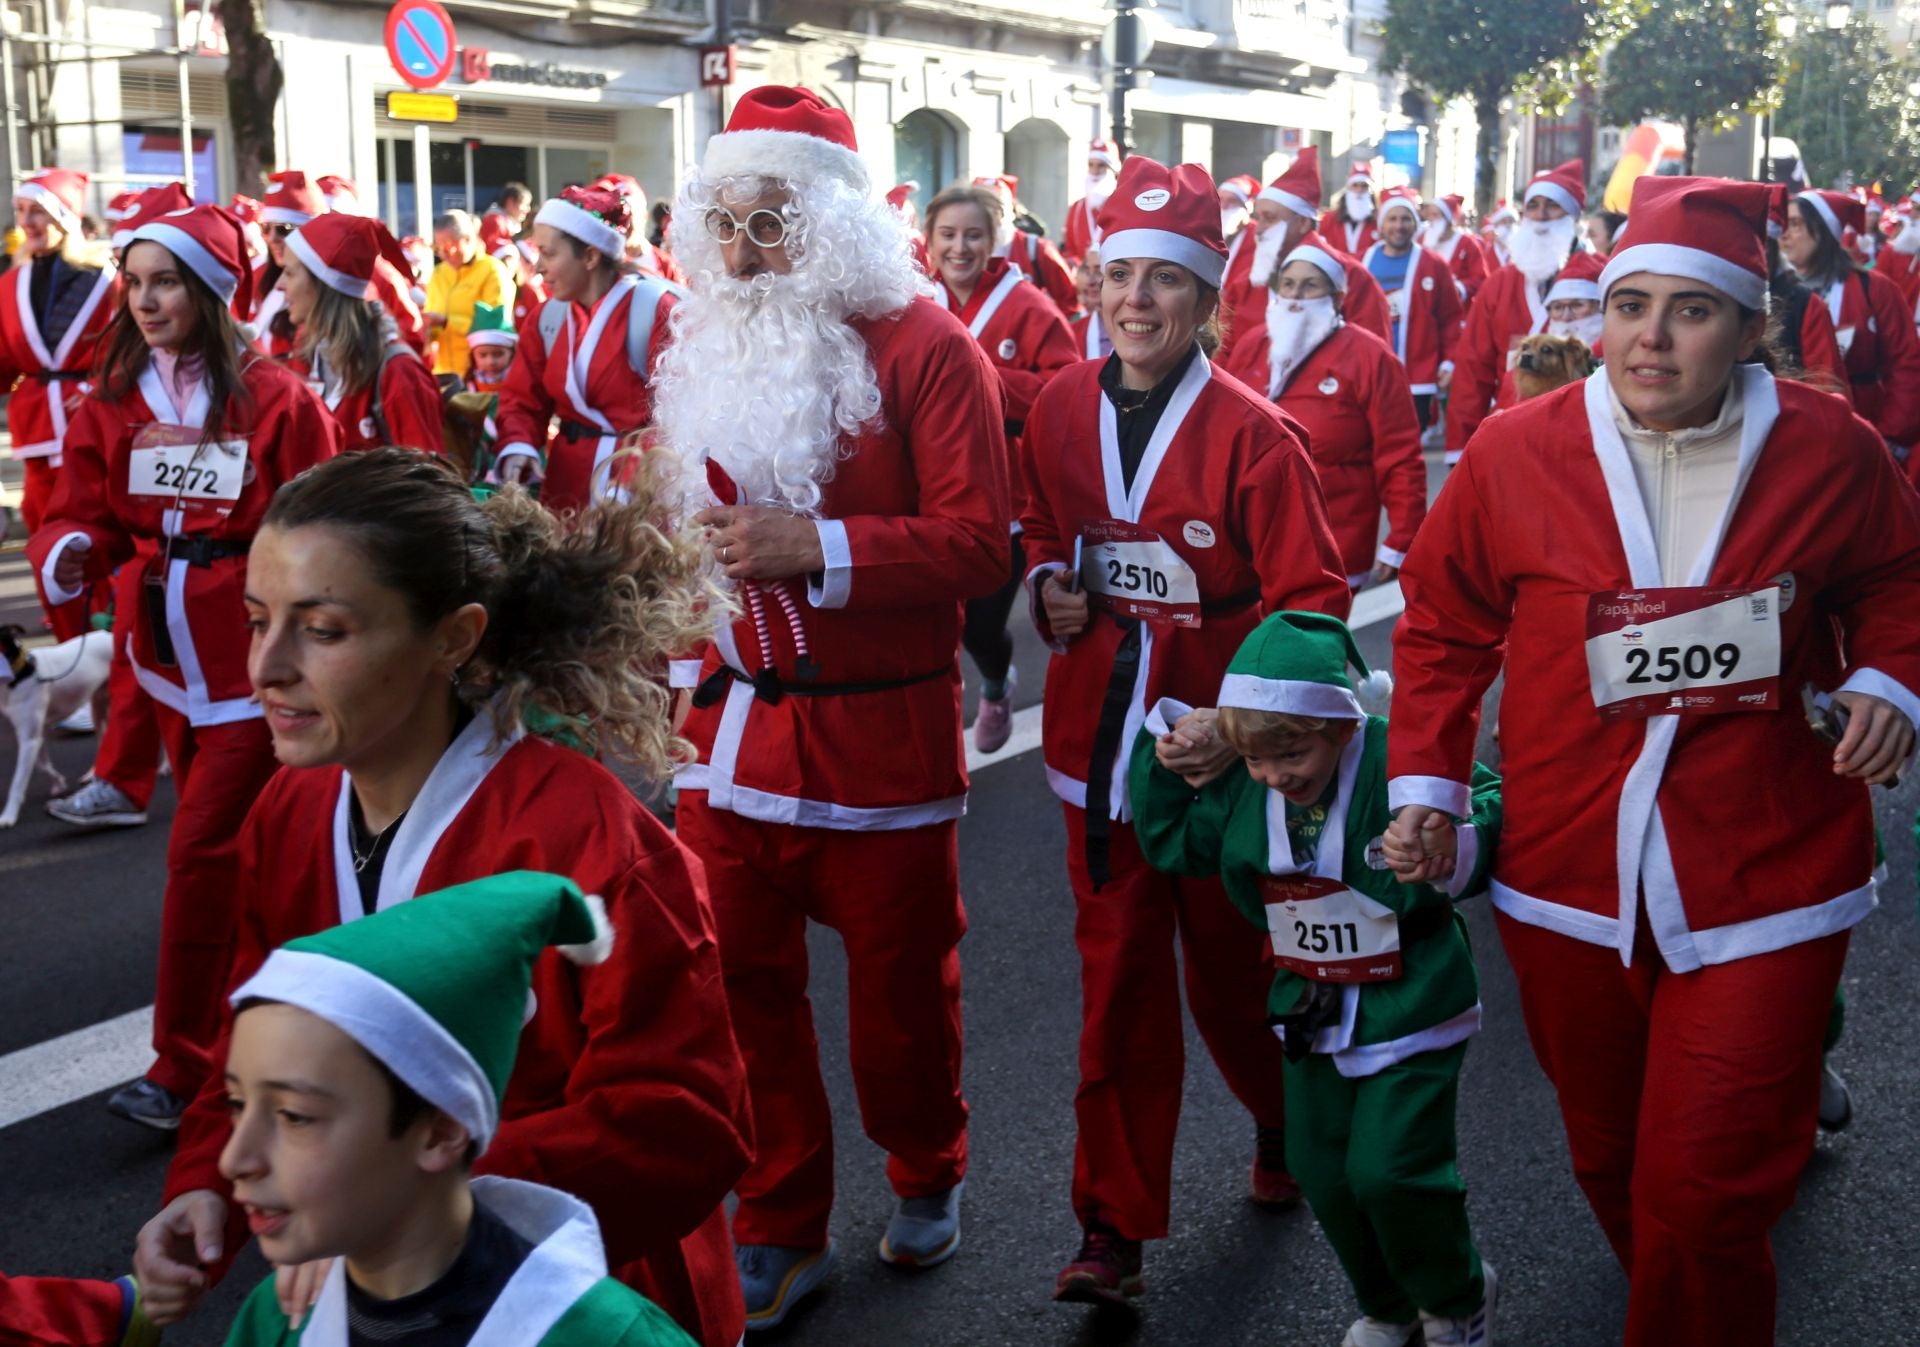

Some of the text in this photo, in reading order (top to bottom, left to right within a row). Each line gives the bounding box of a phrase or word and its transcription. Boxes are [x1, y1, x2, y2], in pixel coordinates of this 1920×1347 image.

[154, 462, 218, 494] 2272
[1107, 559, 1168, 598] 2510
[1597, 600, 1666, 617] Papá Noel
[1625, 642, 1740, 684] 2509
[1684, 696, 1715, 704] OVIEDO
[1294, 920, 1358, 954] 2511
